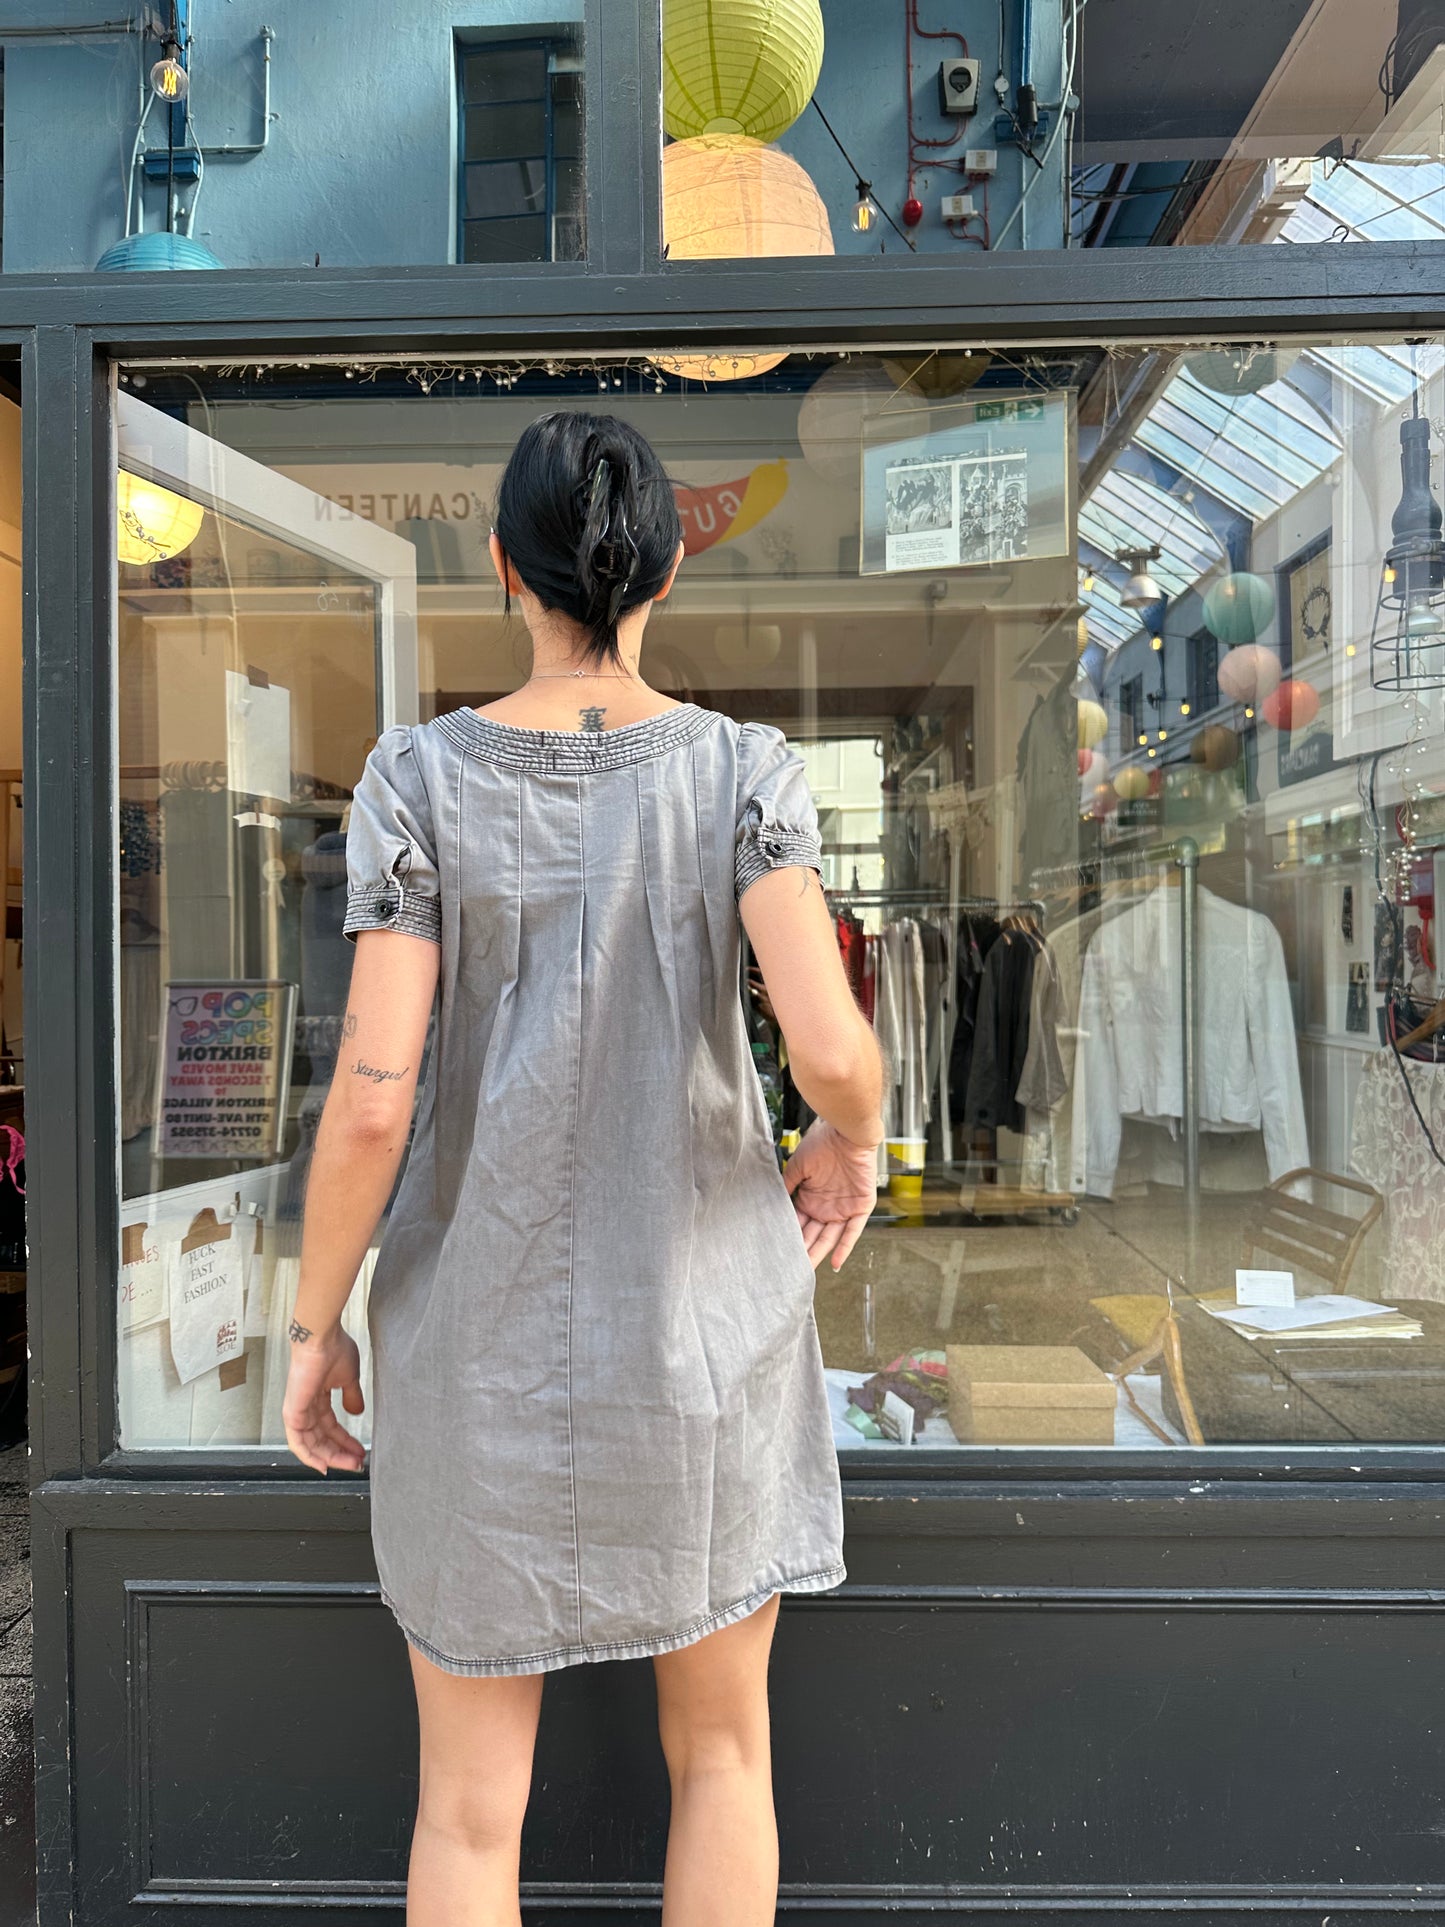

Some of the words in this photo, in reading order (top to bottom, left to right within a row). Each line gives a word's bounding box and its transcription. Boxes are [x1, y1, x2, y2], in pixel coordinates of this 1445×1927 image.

[350, 1059, 410, 1083] Stargirl
[188, 1243, 216, 1265] FUCK
[190, 1261, 216, 1282] FAST
[184, 1273, 228, 1304] FASHION
